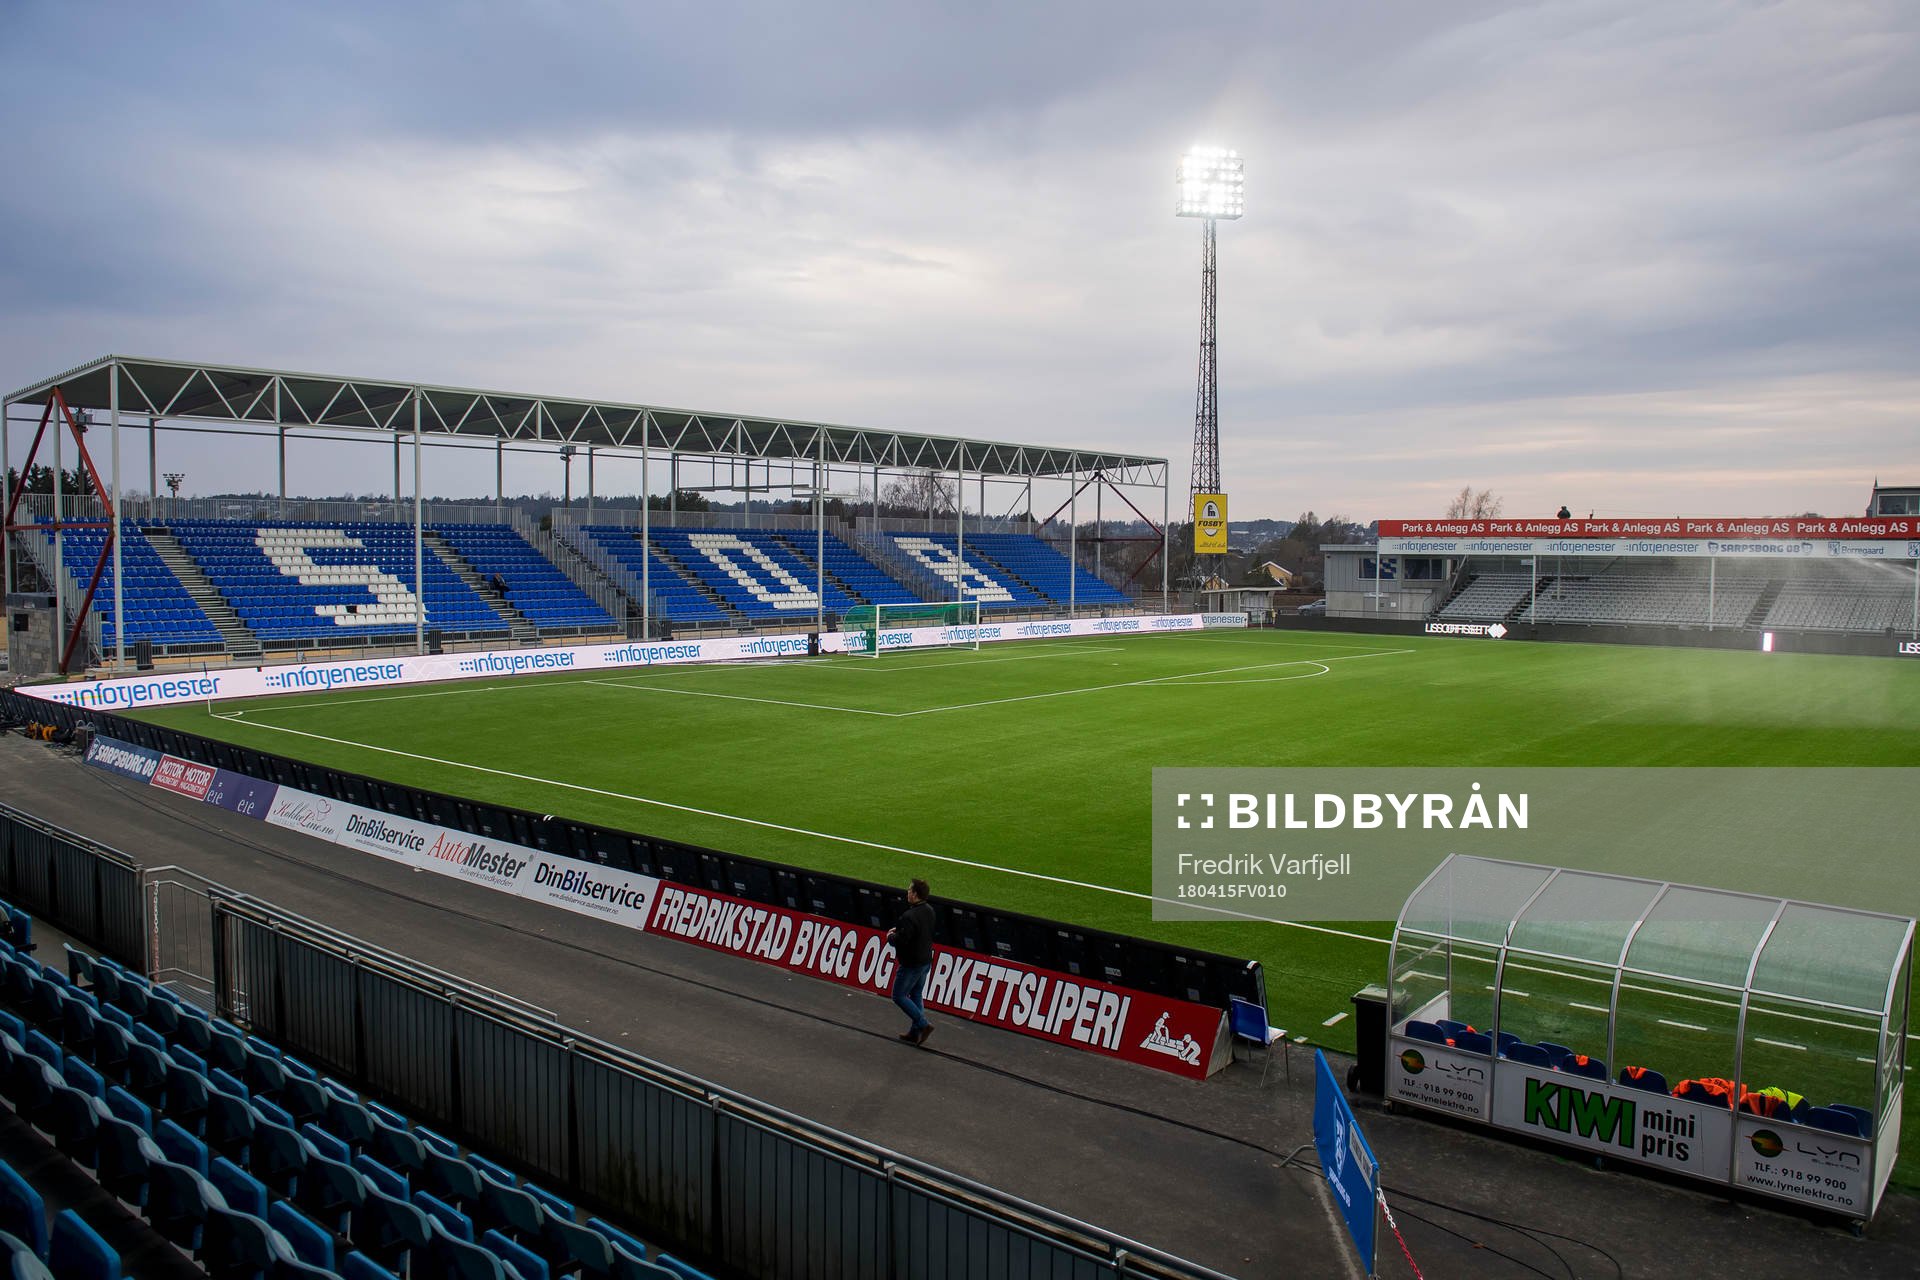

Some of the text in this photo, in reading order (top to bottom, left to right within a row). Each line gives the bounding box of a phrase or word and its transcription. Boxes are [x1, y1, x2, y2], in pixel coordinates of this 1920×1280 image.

[1402, 523, 1485, 534] Park & Anlegg AS
[1490, 523, 1579, 534] Park & Anlegg AS
[1584, 523, 1680, 534] Park & Anlegg AS
[1686, 523, 1790, 534] Park & Anlegg AS
[1797, 523, 1825, 532] Park
[1828, 523, 1838, 532] &
[1841, 523, 1886, 534] Anlegg
[1889, 523, 1908, 532] AS
[1720, 544, 1784, 553] SARPSBORG
[616, 644, 701, 665] infotjenester
[751, 637, 823, 656] infotjenesr
[281, 663, 404, 689] infotjenester
[474, 652, 575, 675] infotjenester
[95, 744, 157, 777] SARPSBORG 08
[160, 760, 185, 778] MOTOR
[183, 767, 211, 786] MOTOR
[346, 814, 425, 851] DinBilservice
[427, 831, 527, 879] AutoMester
[534, 862, 645, 910] DinBilservice
[651, 887, 1131, 1051] FREDRIKSTAD BYGG OG RKETTSLIPERI
[1398, 1088, 1479, 1114] www.lynelektro.no
[1424, 1083, 1440, 1094] 918
[1443, 1087, 1454, 1096] 99
[1457, 1091, 1474, 1102] 900
[1524, 1077, 1637, 1150] KIWI
[1642, 1108, 1696, 1138] mini
[1641, 1131, 1690, 1162] pris
[1746, 1174, 1853, 1206] www.lynelektro.no
[1781, 1168, 1803, 1180] 918
[1806, 1173, 1821, 1183] 99
[1824, 1178, 1847, 1191] 900
